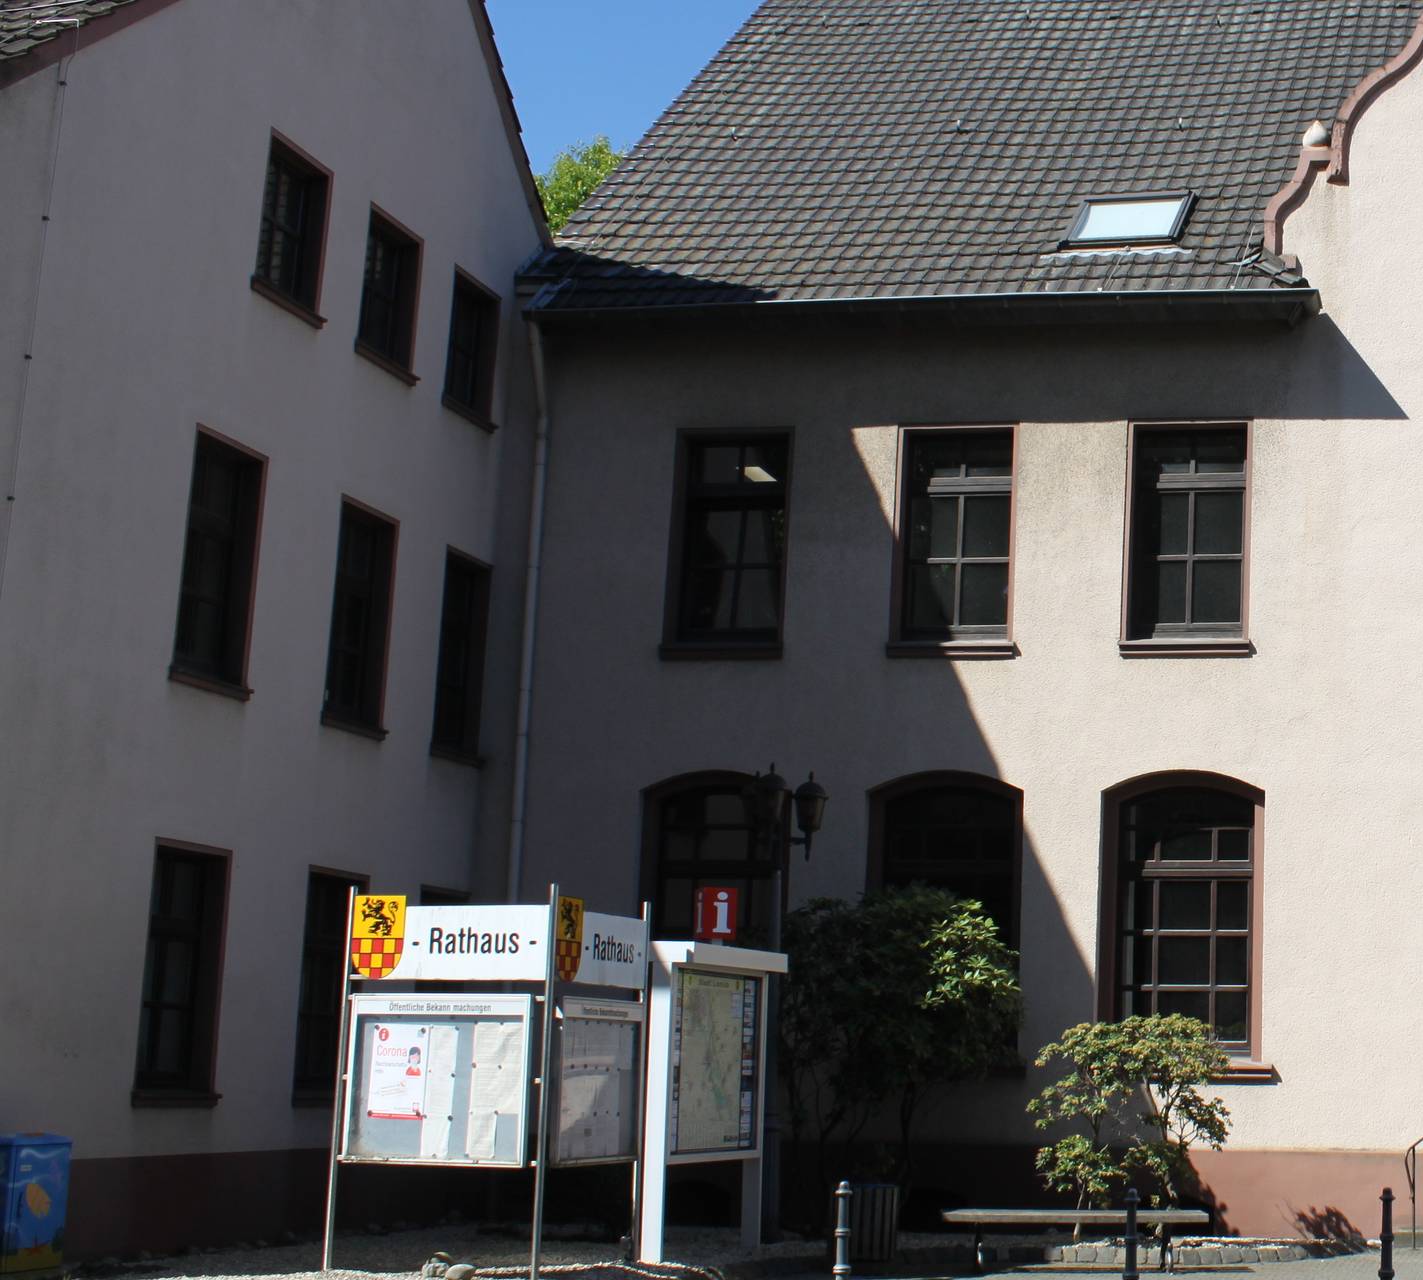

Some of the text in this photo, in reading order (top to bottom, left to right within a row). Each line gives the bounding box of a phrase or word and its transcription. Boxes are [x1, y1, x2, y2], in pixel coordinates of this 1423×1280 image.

[711, 891, 731, 934] i
[429, 926, 520, 955] Rathaus
[593, 933, 635, 964] Rathaus
[389, 1002, 424, 1011] Öffentliche
[376, 1045, 407, 1056] Corona
